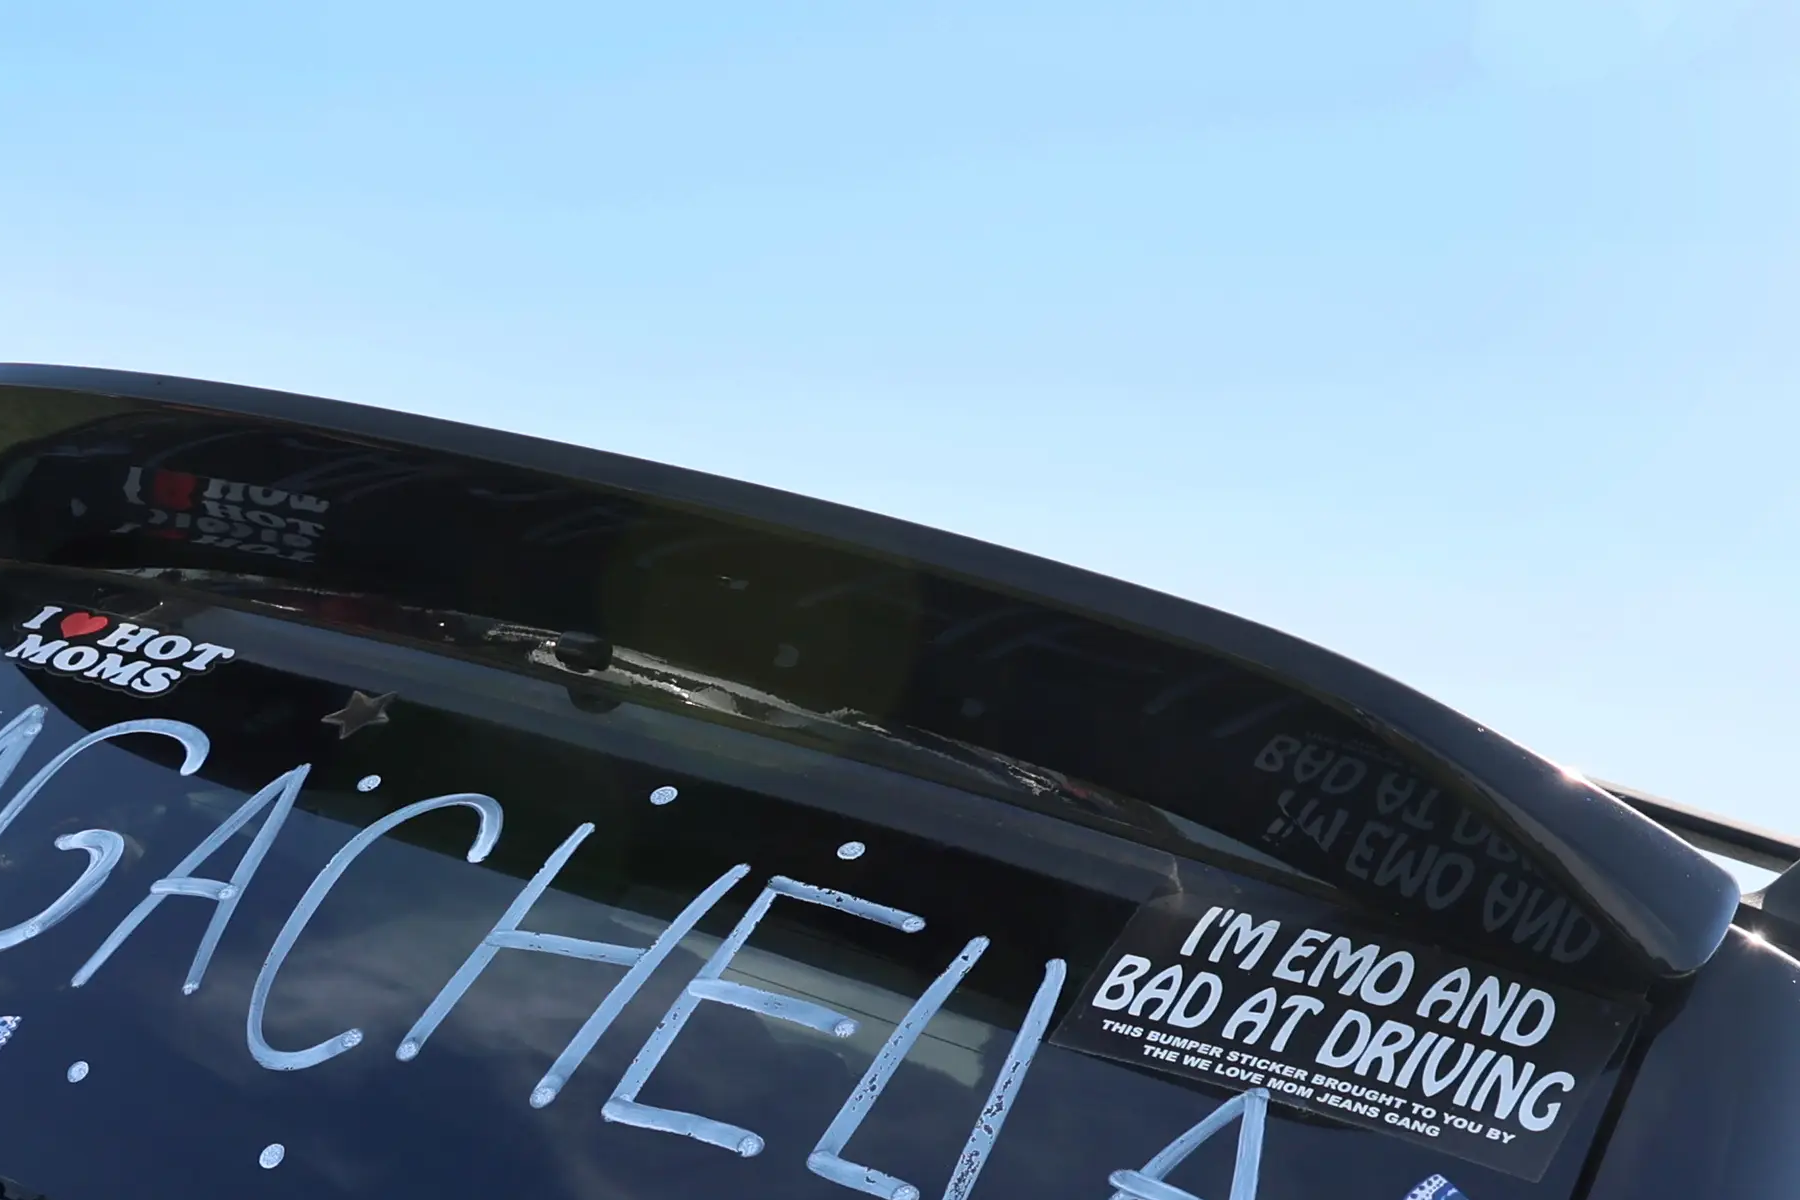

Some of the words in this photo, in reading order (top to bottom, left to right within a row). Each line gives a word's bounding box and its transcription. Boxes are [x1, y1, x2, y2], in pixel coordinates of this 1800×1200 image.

[5, 634, 181, 693] MOMS
[23, 606, 62, 630] I
[98, 623, 235, 671] HOT
[1180, 906, 1281, 971] I'M
[1273, 929, 1415, 1005] EMO
[1416, 966, 1556, 1047] AND
[1092, 954, 1224, 1029] BAD
[1223, 987, 1325, 1053] AT
[1315, 1009, 1576, 1132] DRIVING
[1102, 1019, 1144, 1038] THIS
[1146, 1029, 1224, 1059] BUMPER
[1226, 1051, 1308, 1082] STICKER
[1311, 1072, 1407, 1109] BROUGHT
[1411, 1102, 1437, 1119] TO
[1442, 1112, 1483, 1134] YOU
[1486, 1128, 1516, 1144] BY
[1143, 1045, 1180, 1062] THE
[1182, 1055, 1212, 1072] WE
[1214, 1063, 1266, 1085] LOVE
[1266, 1077, 1314, 1099] MOM
[1316, 1092, 1380, 1119] JEANS
[1384, 1111, 1441, 1137] GANG
